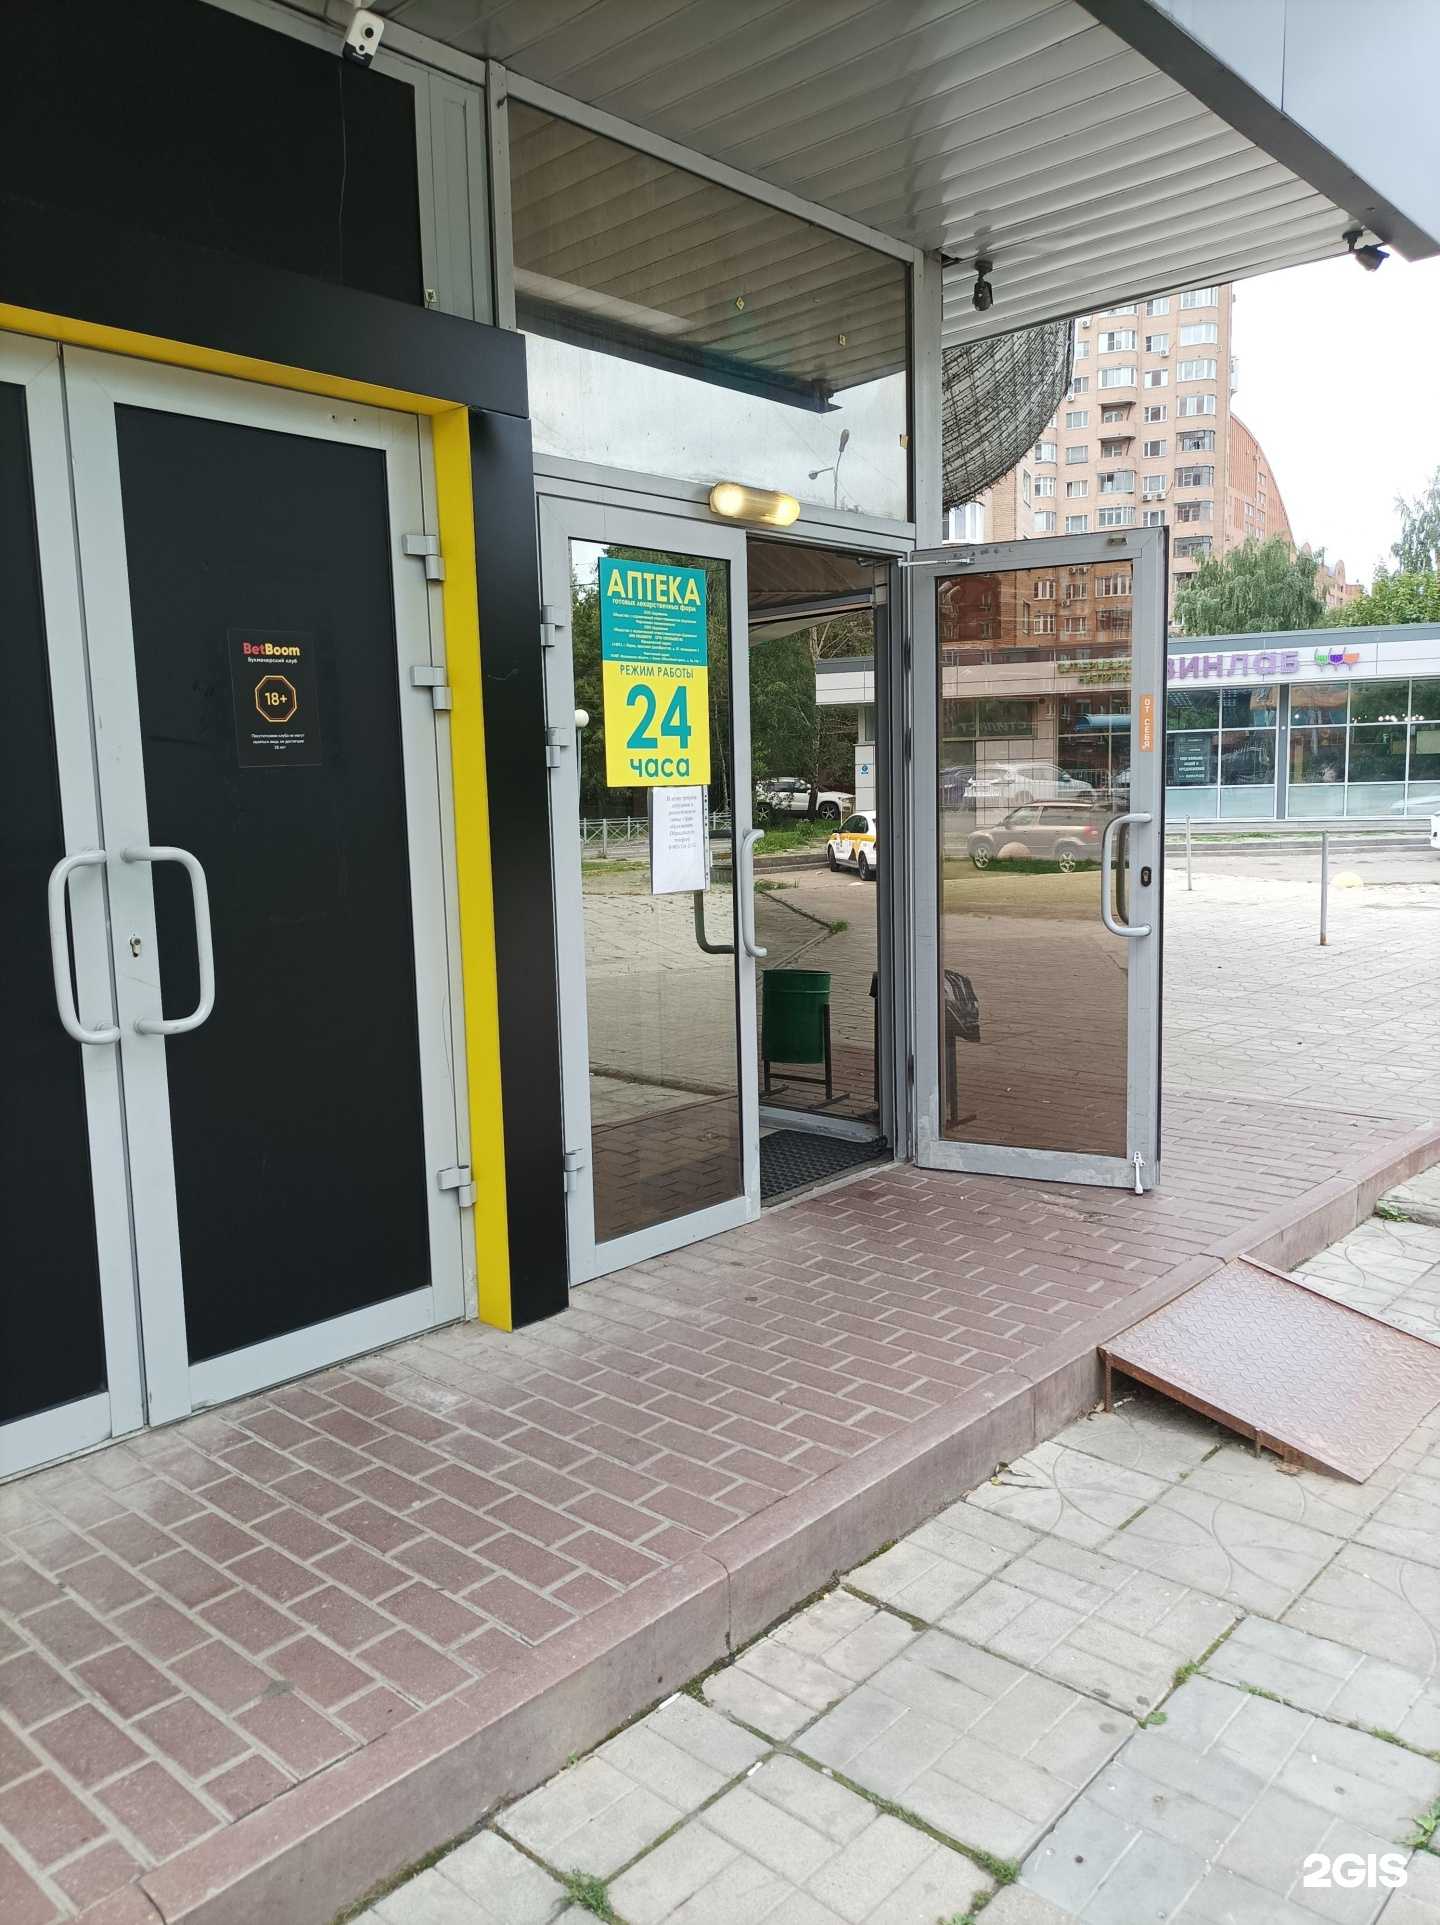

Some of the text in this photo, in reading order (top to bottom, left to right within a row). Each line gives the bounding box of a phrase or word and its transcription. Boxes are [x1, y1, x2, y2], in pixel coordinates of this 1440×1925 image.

[607, 568, 701, 606] АПТЕКА
[243, 642, 300, 656] BetBoom
[619, 664, 694, 679] РЕЖИМ РАБОТЫ
[264, 692, 288, 706] 18+
[626, 683, 692, 749] 24
[629, 757, 690, 778] часа
